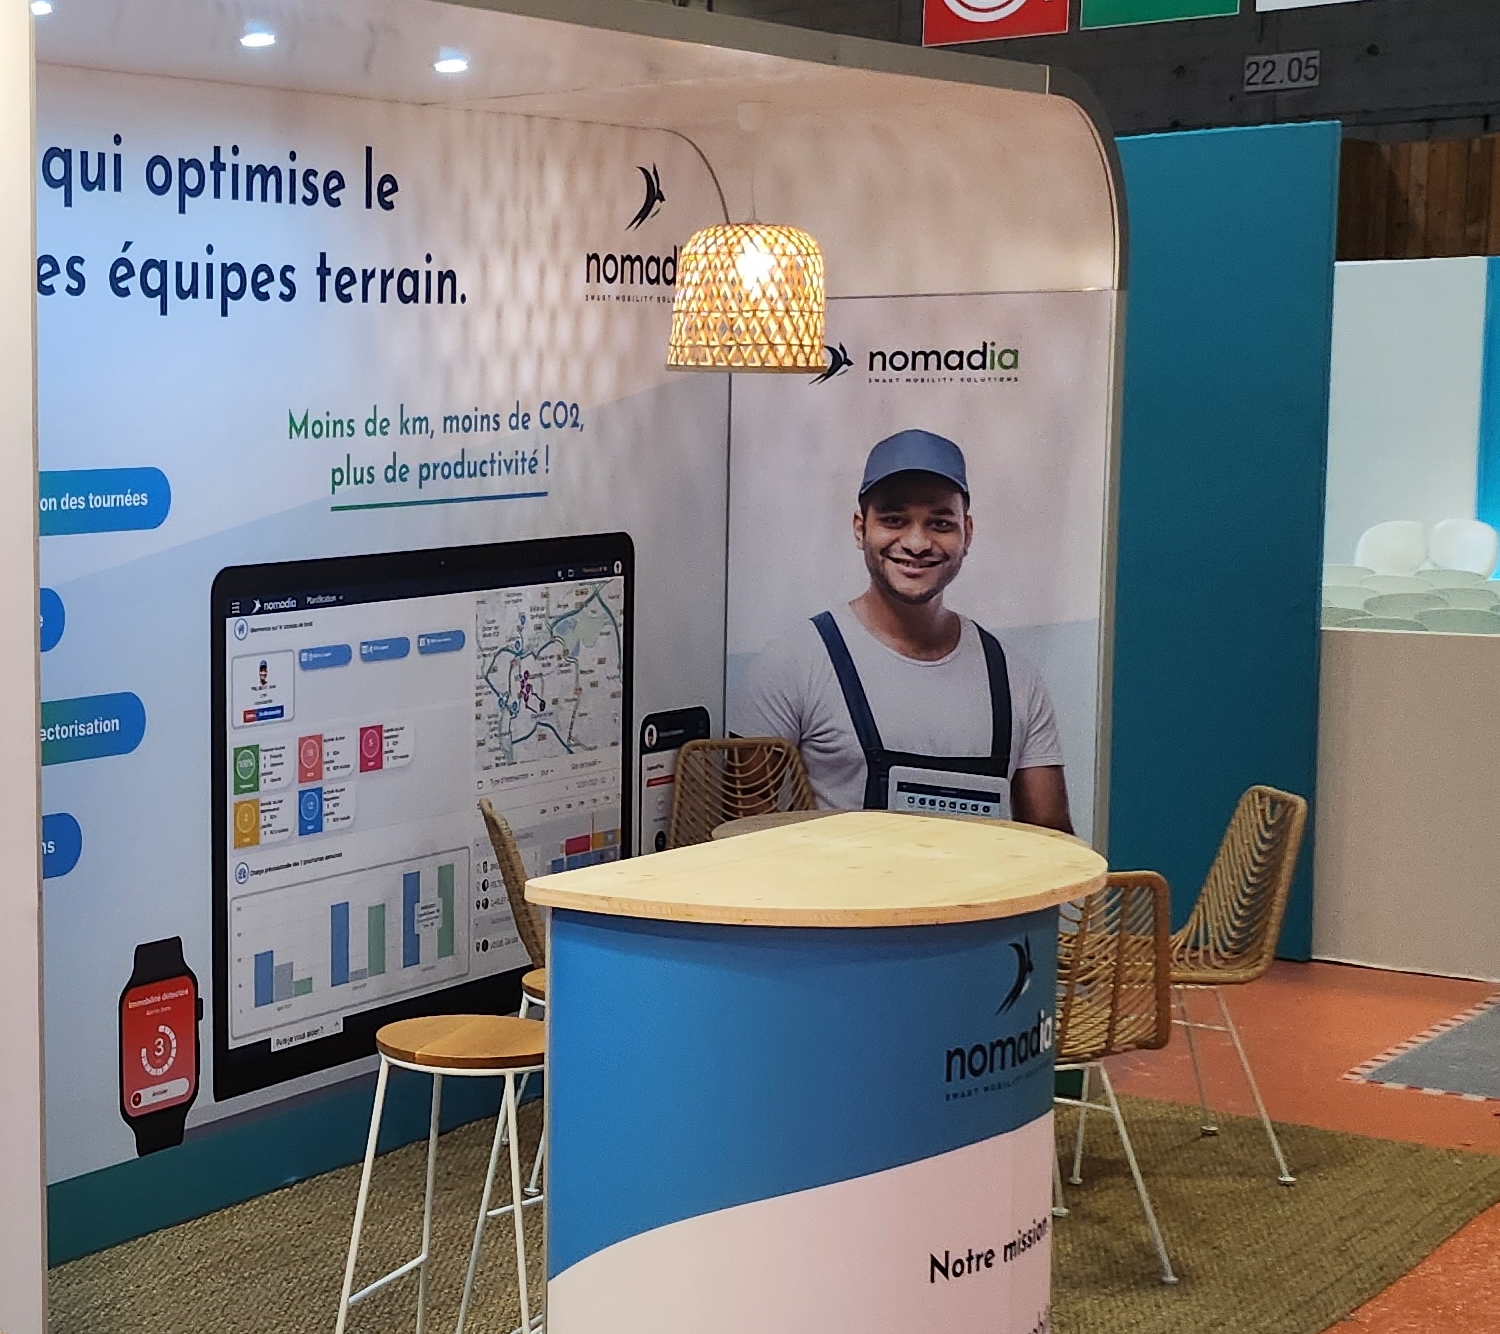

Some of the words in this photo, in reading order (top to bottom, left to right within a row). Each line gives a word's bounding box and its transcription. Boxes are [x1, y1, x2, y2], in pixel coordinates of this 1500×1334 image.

[1245, 56, 1318, 86] 22.05
[42, 134, 122, 208] qui
[145, 145, 346, 215] optimise
[365, 146, 399, 211] le
[37, 254, 86, 296] es
[108, 241, 297, 317] équipes
[316, 252, 467, 304] terrain.
[585, 245, 680, 286] nomad
[869, 341, 1019, 371] nomadia
[288, 408, 355, 440] Moins
[364, 404, 390, 437] de
[400, 403, 434, 439] km,
[443, 407, 501, 434] moins
[508, 400, 531, 430] de
[539, 400, 584, 432] CO2,
[331, 453, 375, 495] plus
[384, 451, 409, 483] de
[418, 448, 538, 489] productivité
[39, 497, 57, 511] on
[61, 493, 86, 510] des
[88, 488, 148, 509] tournées
[39, 717, 119, 742] ectorisation
[154, 1037, 165, 1057] 3
[945, 1009, 1053, 1083] nomadia
[929, 1248, 996, 1283] Notre
